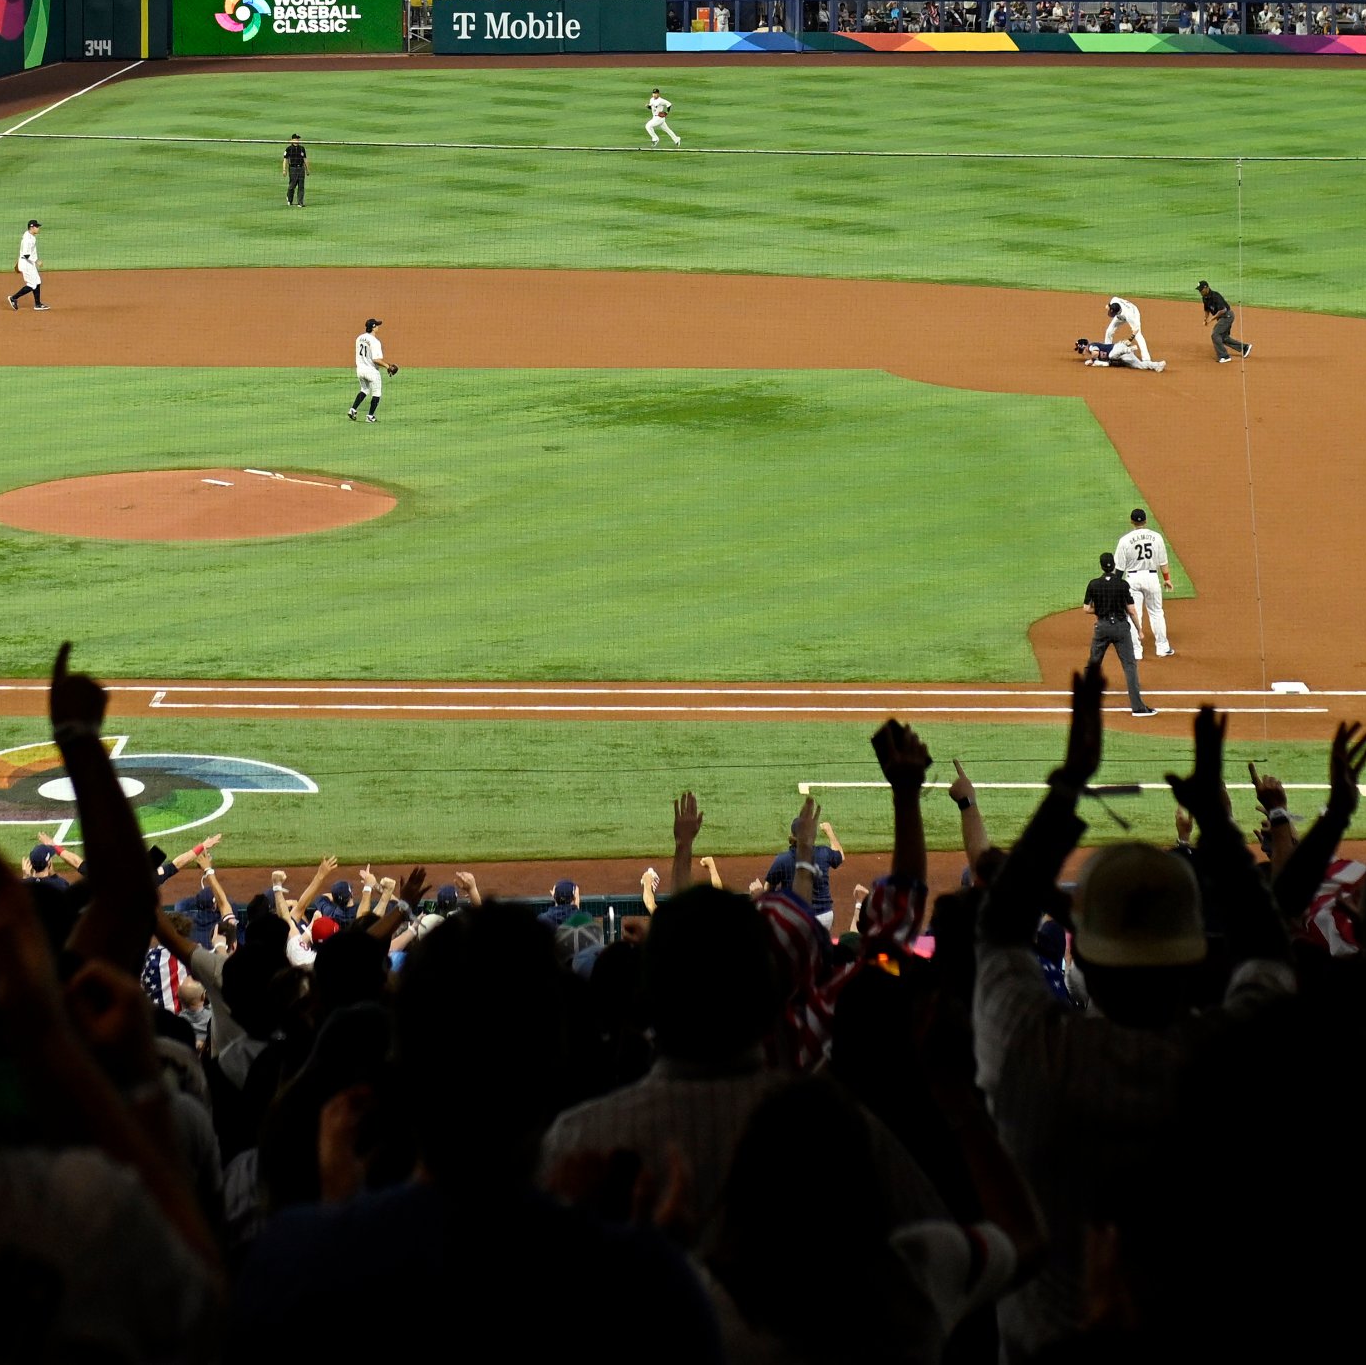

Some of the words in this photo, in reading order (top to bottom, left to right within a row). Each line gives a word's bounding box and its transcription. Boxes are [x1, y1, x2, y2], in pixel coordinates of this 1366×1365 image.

[273, 6, 361, 20] BASEBALL
[484, 12, 581, 39] Mobile
[85, 39, 112, 57] 344
[1135, 543, 1153, 560] 25
